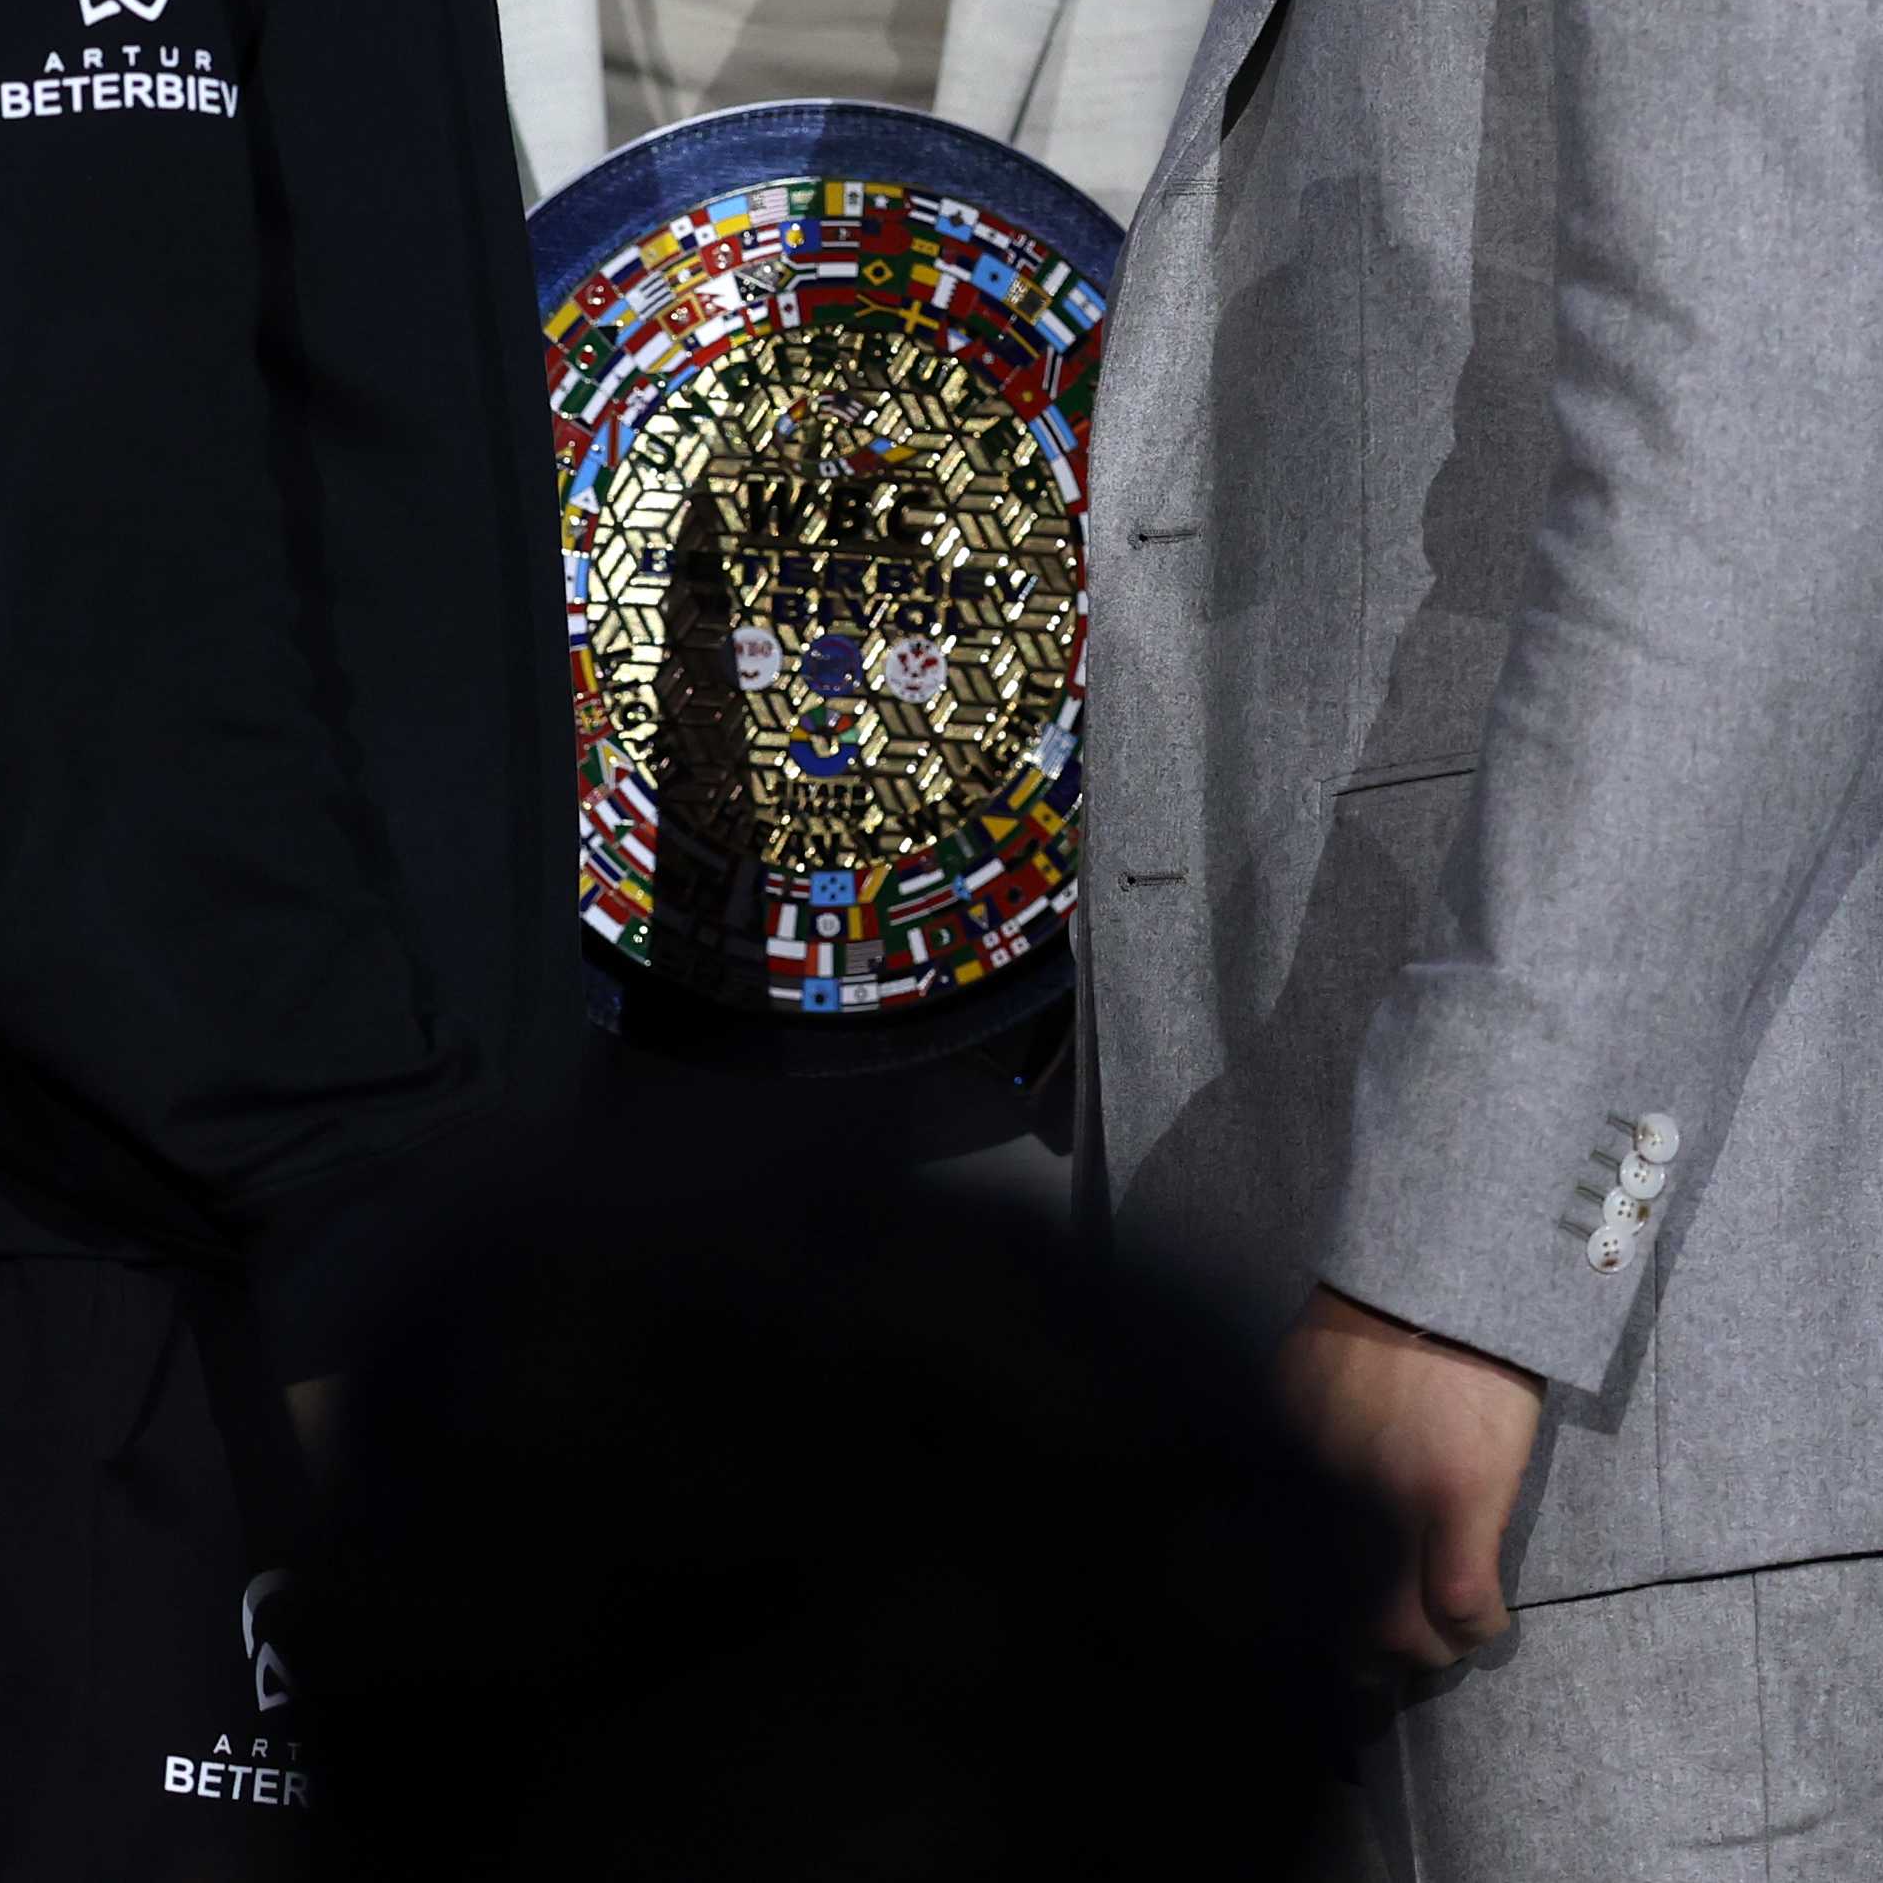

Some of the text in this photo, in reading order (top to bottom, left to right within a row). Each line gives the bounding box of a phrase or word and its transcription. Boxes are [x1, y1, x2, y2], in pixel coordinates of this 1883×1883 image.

[43, 44, 213, 75] ARTUR
[0, 70, 239, 121] BETERBIEV
[744, 477, 933, 541] WBC
[771, 590, 976, 637] BIVOL
[163, 1754, 310, 1809] BETER
